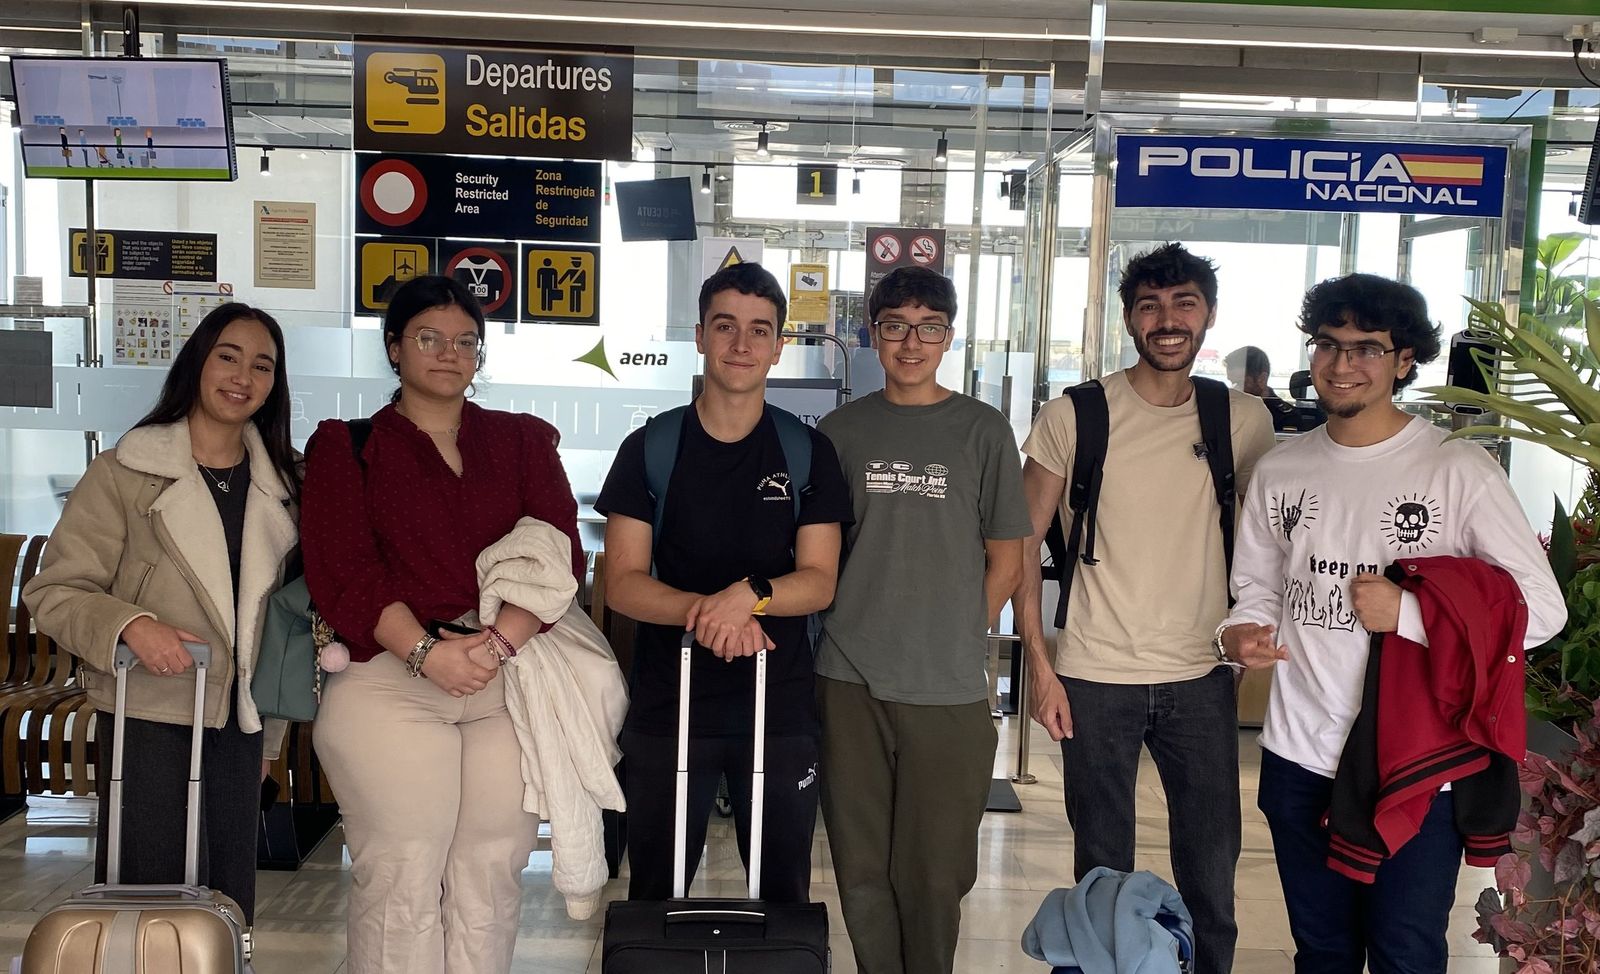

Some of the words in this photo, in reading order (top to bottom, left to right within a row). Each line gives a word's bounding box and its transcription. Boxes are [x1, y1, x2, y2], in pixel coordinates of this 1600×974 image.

[465, 54, 612, 95] Departures
[465, 103, 587, 142] Salidas
[455, 172, 499, 188] Security
[535, 169, 562, 181] Zona
[535, 184, 596, 199] Restringida
[810, 171, 824, 198] 1
[455, 187, 509, 201] Restricted
[1305, 182, 1478, 206] NACIONAL
[454, 202, 480, 214] Area
[535, 199, 549, 211] de
[535, 214, 589, 228] Seguridad
[619, 352, 669, 366] aena
[756, 476, 771, 491] PUMA
[865, 472, 897, 481] Tennis
[897, 473, 926, 484] Court
[893, 482, 921, 494] Match
[919, 483, 947, 495] Point
[1309, 553, 1349, 579] keep
